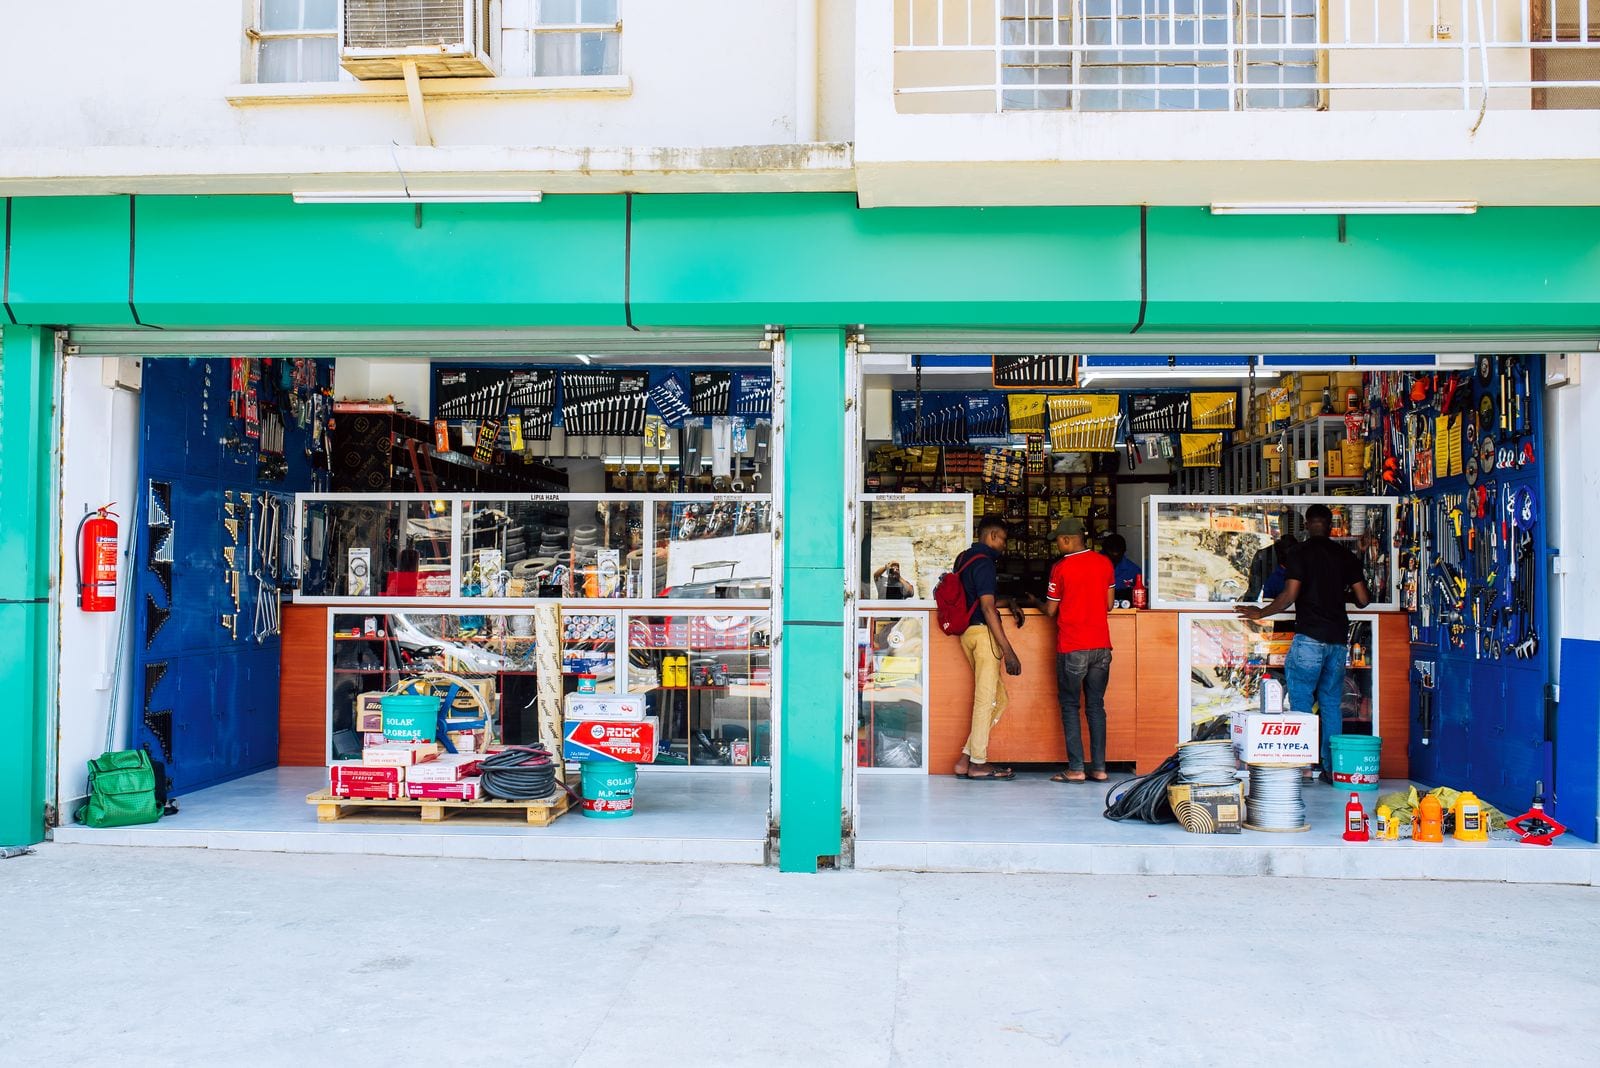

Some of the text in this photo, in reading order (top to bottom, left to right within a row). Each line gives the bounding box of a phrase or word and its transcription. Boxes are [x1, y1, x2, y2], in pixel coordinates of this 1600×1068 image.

[386, 718, 414, 726] SOLAR
[606, 727, 640, 738] ROCK
[1261, 722, 1302, 736] TESON
